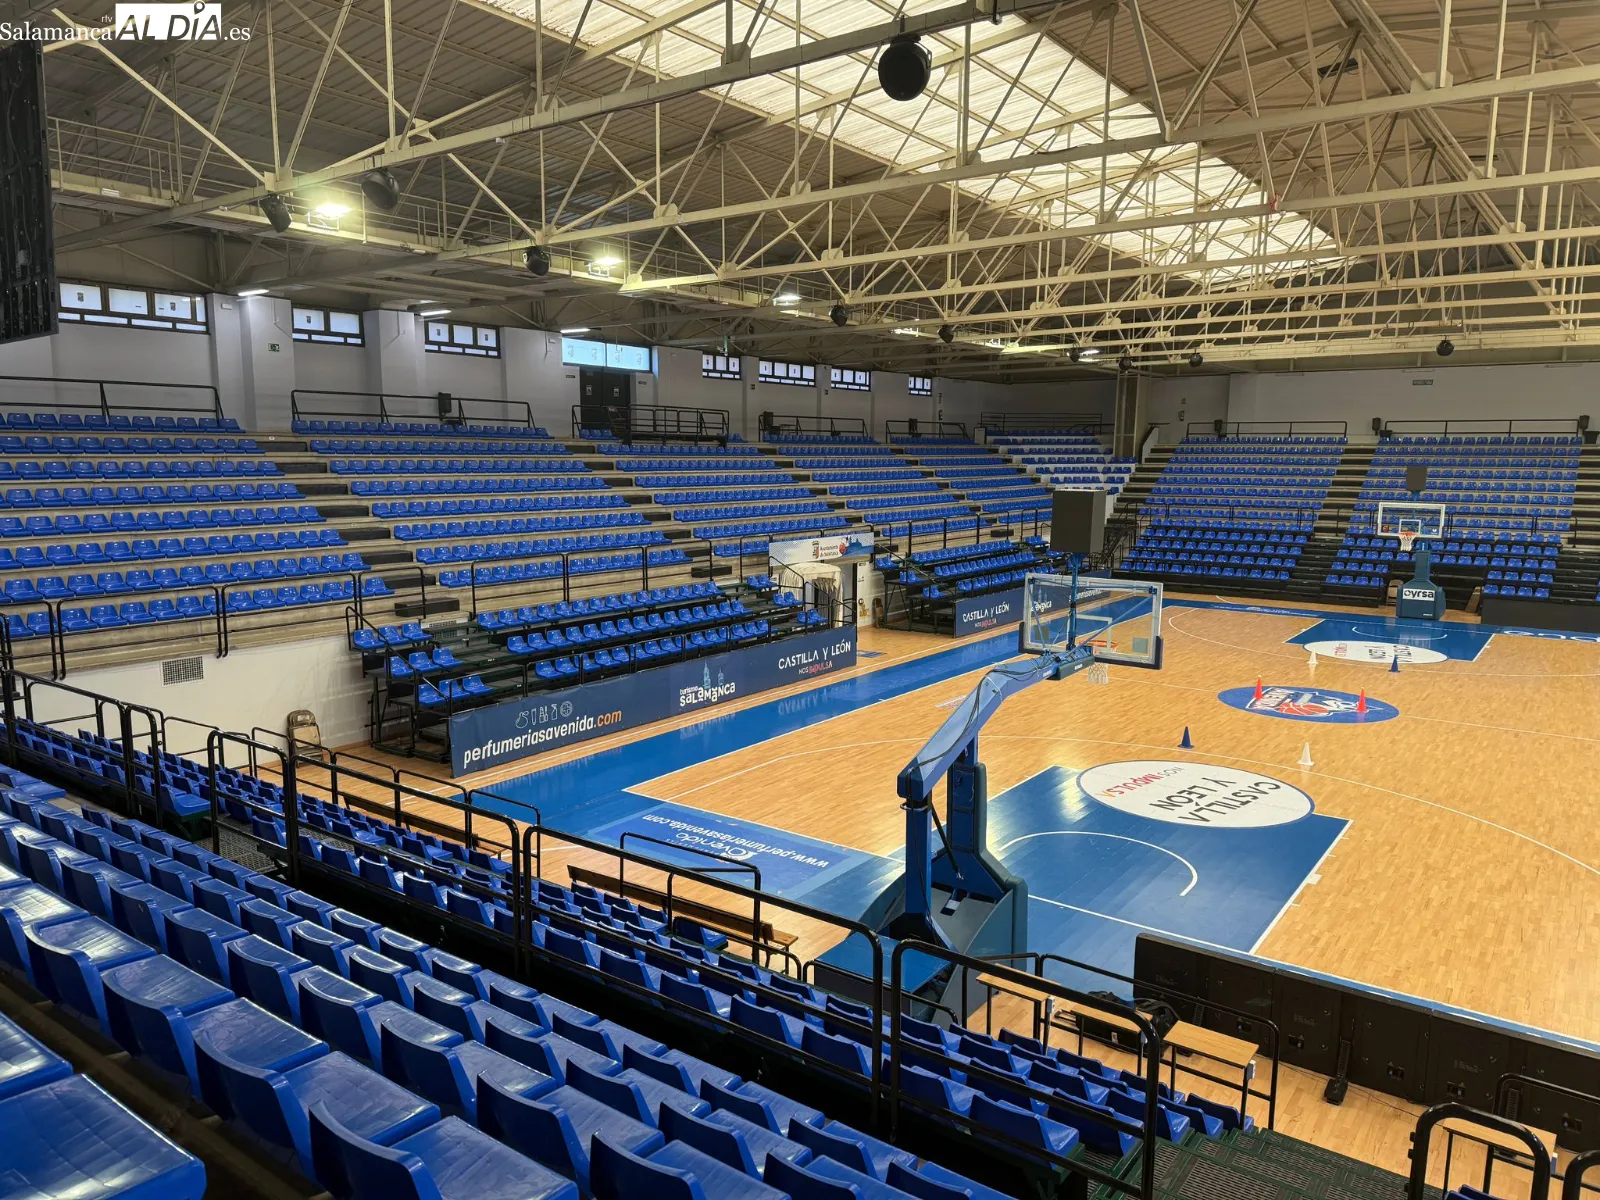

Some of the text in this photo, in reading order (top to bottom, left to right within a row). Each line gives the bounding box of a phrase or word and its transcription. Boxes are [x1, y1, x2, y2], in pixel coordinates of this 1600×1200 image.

[962, 601, 1010, 623] CASTILLA Y LEÓN
[778, 638, 851, 670] CASTILLA Y LEÓN
[463, 710, 622, 769] perfumeriasavenida.com
[1148, 777, 1236, 811] Y LEÓN
[1178, 781, 1282, 823] CASTILLA
[642, 814, 830, 869] www.perfumeriasavenida.com
